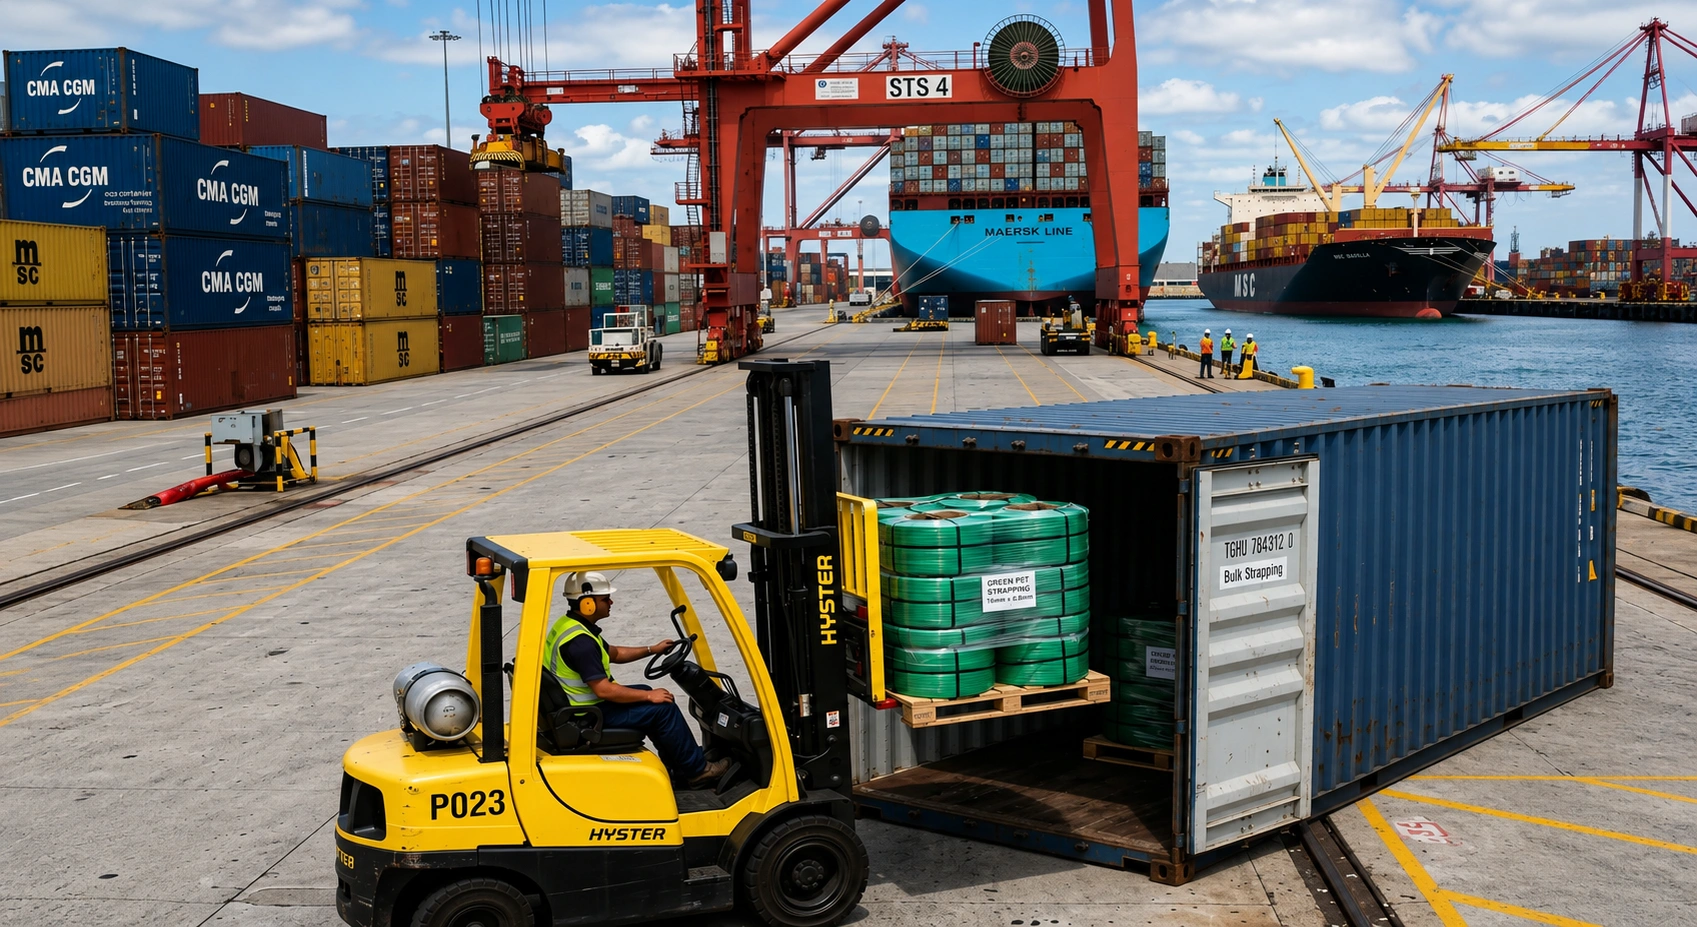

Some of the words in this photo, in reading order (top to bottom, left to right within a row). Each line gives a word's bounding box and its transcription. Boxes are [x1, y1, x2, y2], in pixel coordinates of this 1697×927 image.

[27, 80, 59, 97] CMA
[63, 79, 95, 96] CGM
[889, 77, 930, 97] STS
[935, 76, 949, 96] 4
[23, 167, 63, 187] CMA
[68, 166, 108, 186] CGM
[197, 178, 228, 203] CMA
[231, 183, 259, 206] CGM
[984, 226, 1040, 238] MAERSK
[1044, 226, 1073, 236] LINE
[202, 271, 233, 293] CMA
[236, 272, 264, 293] CGM
[1234, 273, 1255, 297] MSC
[1224, 539, 1248, 559] TGHU
[1251, 533, 1284, 555] 784312
[1288, 532, 1294, 548] 0
[987, 578, 1014, 587] GREEN
[1224, 568, 1243, 583] Bulk
[1245, 563, 1283, 580] Strapping
[817, 555, 837, 645] HYSTER
[987, 585, 1030, 595] STRAPPING
[430, 789, 505, 821] P023
[588, 828, 666, 841] HYSTER
